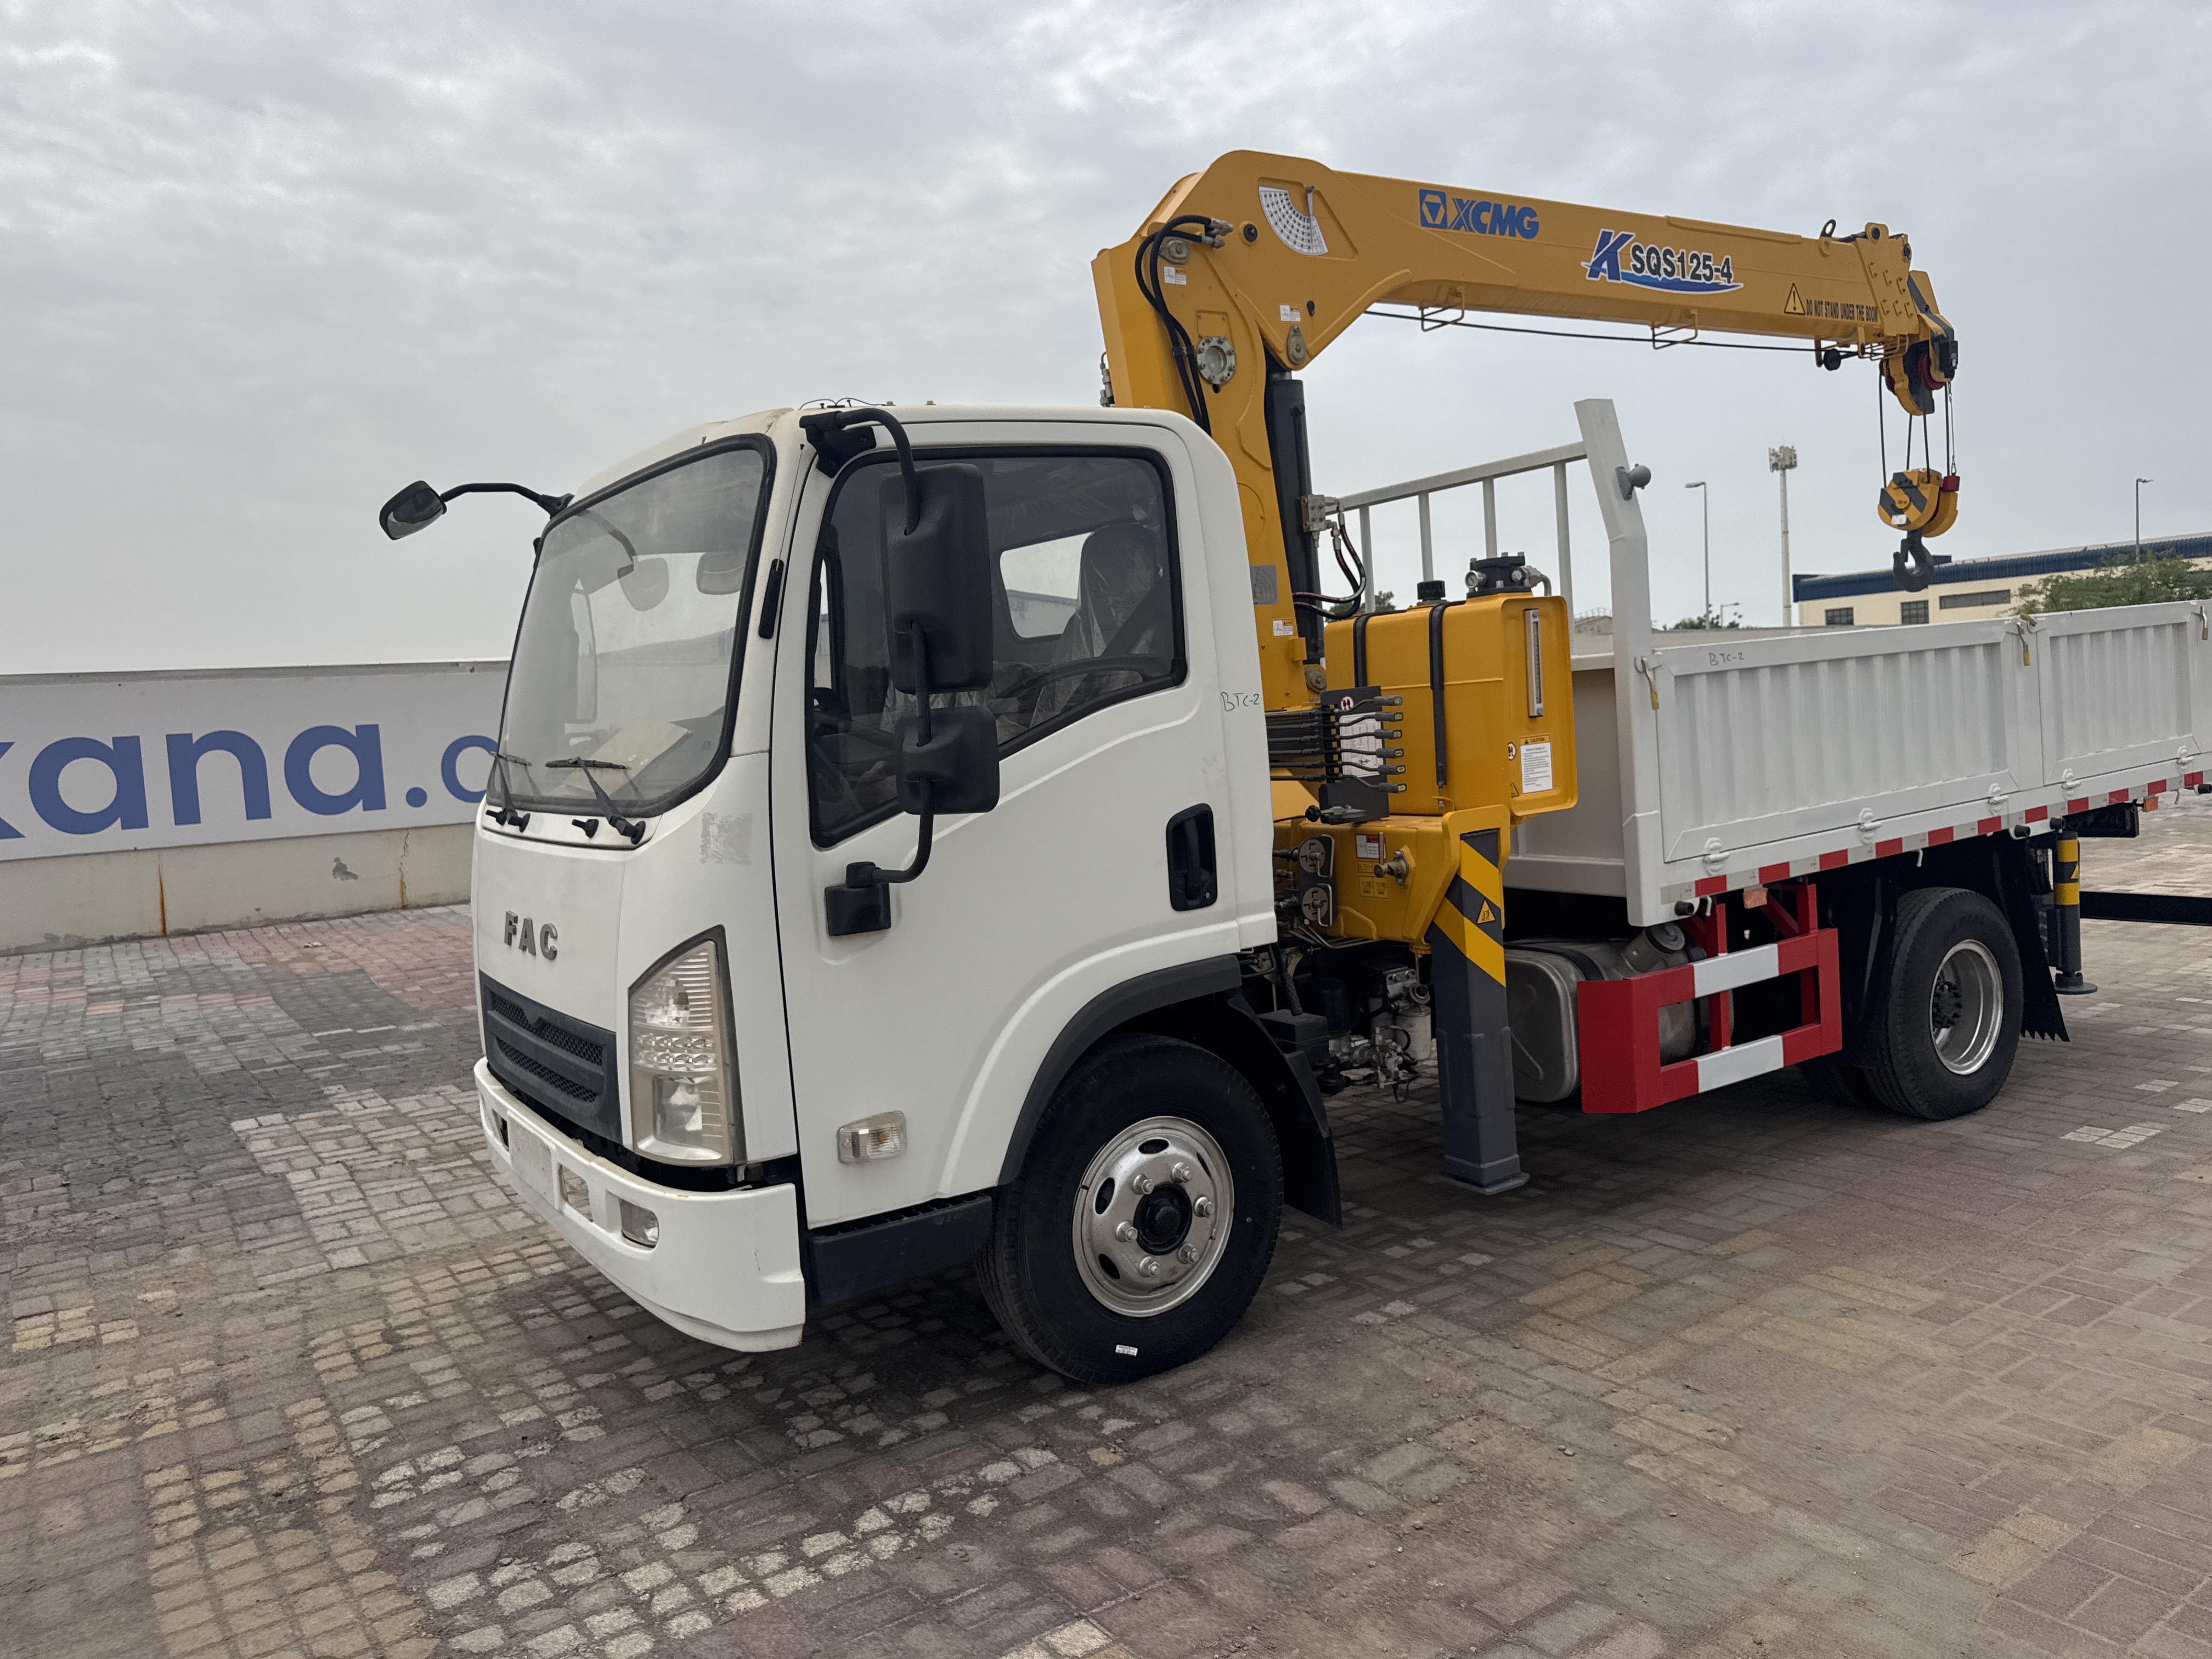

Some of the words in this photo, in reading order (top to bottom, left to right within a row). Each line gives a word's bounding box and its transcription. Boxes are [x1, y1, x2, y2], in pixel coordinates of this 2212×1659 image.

[1448, 197, 1539, 239] XCMG
[1587, 230, 1634, 281] K
[1631, 245, 1733, 284] SQS125-4
[1806, 298, 1813, 317] DO
[1814, 300, 1823, 317] NOT
[1825, 301, 1838, 319] STAND
[1840, 302, 1855, 320] UNDER
[1856, 304, 1865, 321] THE
[1865, 305, 1878, 323] BOOM
[1708, 652, 1745, 666] BTC-2
[1221, 691, 1260, 712] BTC-2
[504, 911, 558, 961] FAC
